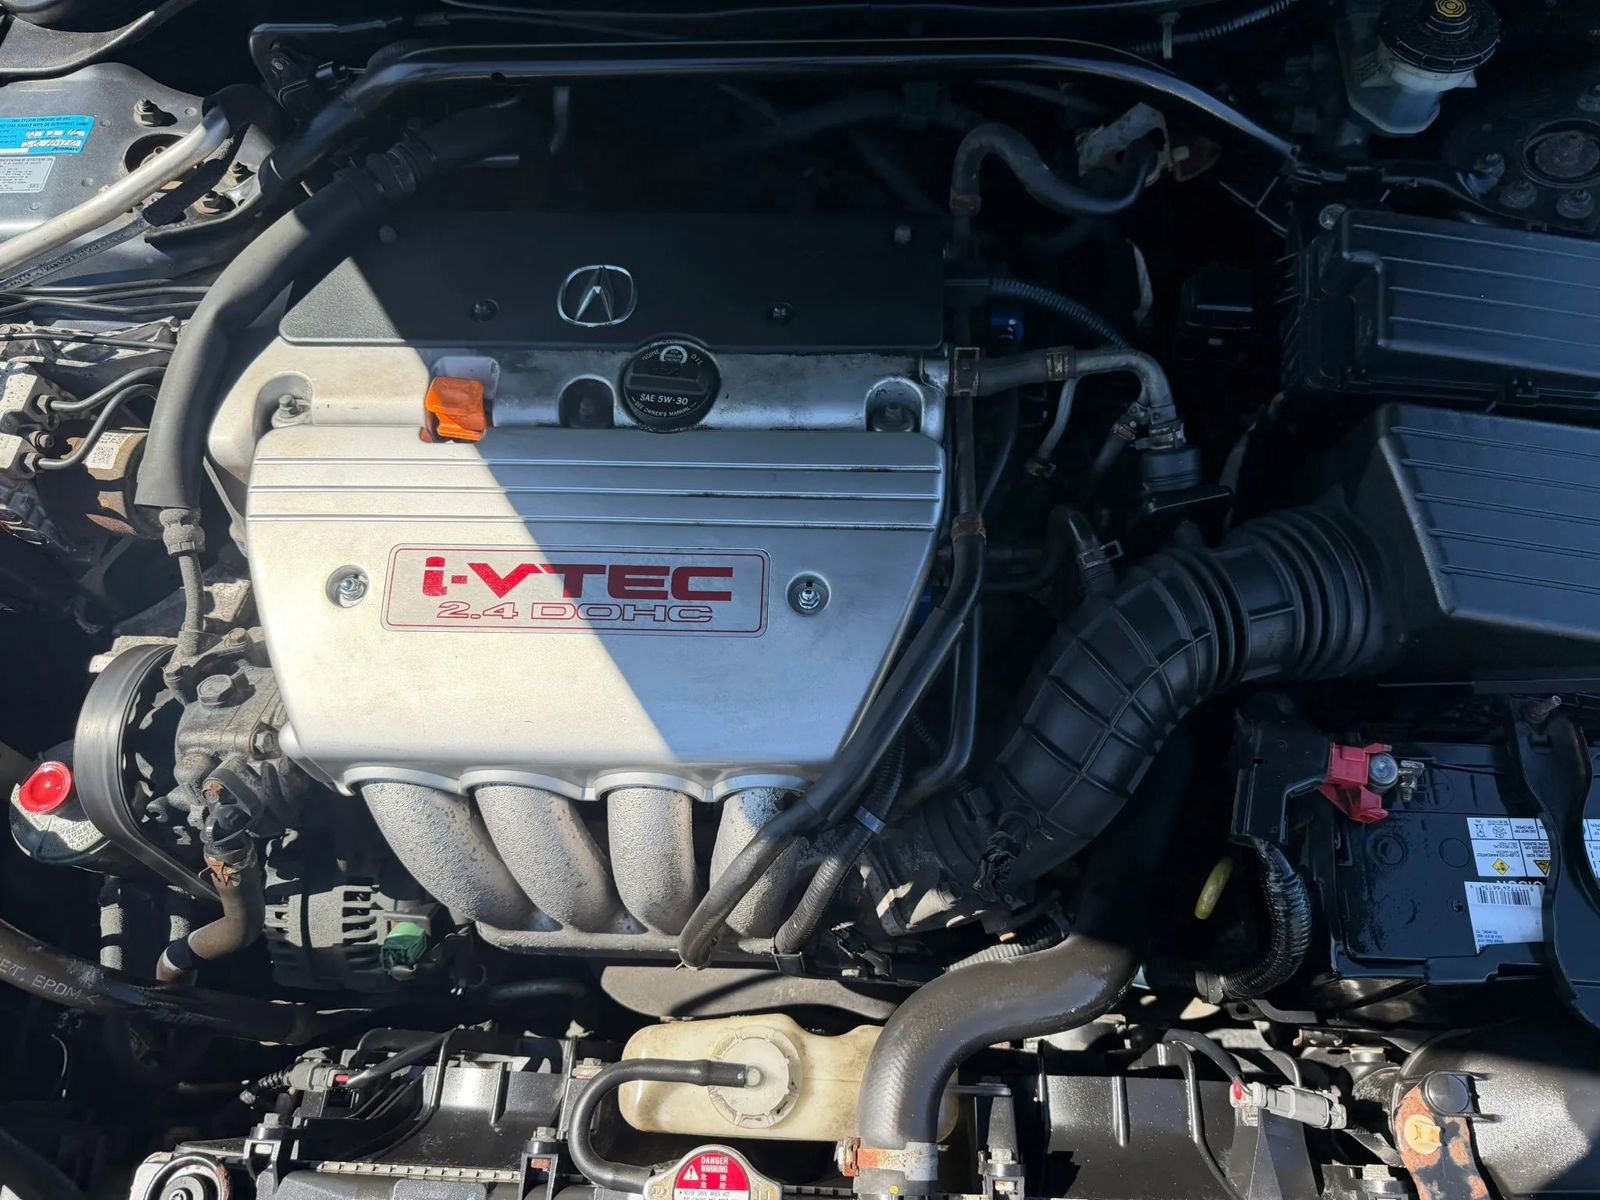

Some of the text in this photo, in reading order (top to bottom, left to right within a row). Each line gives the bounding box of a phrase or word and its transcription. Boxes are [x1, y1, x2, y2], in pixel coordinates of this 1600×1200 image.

[639, 393, 655, 402] SAE
[422, 556, 734, 602] i-VTEC
[436, 601, 713, 623] 2.4 DOHC
[32, 975, 82, 1000] EPDM
[701, 1156, 729, 1164] DANGER
